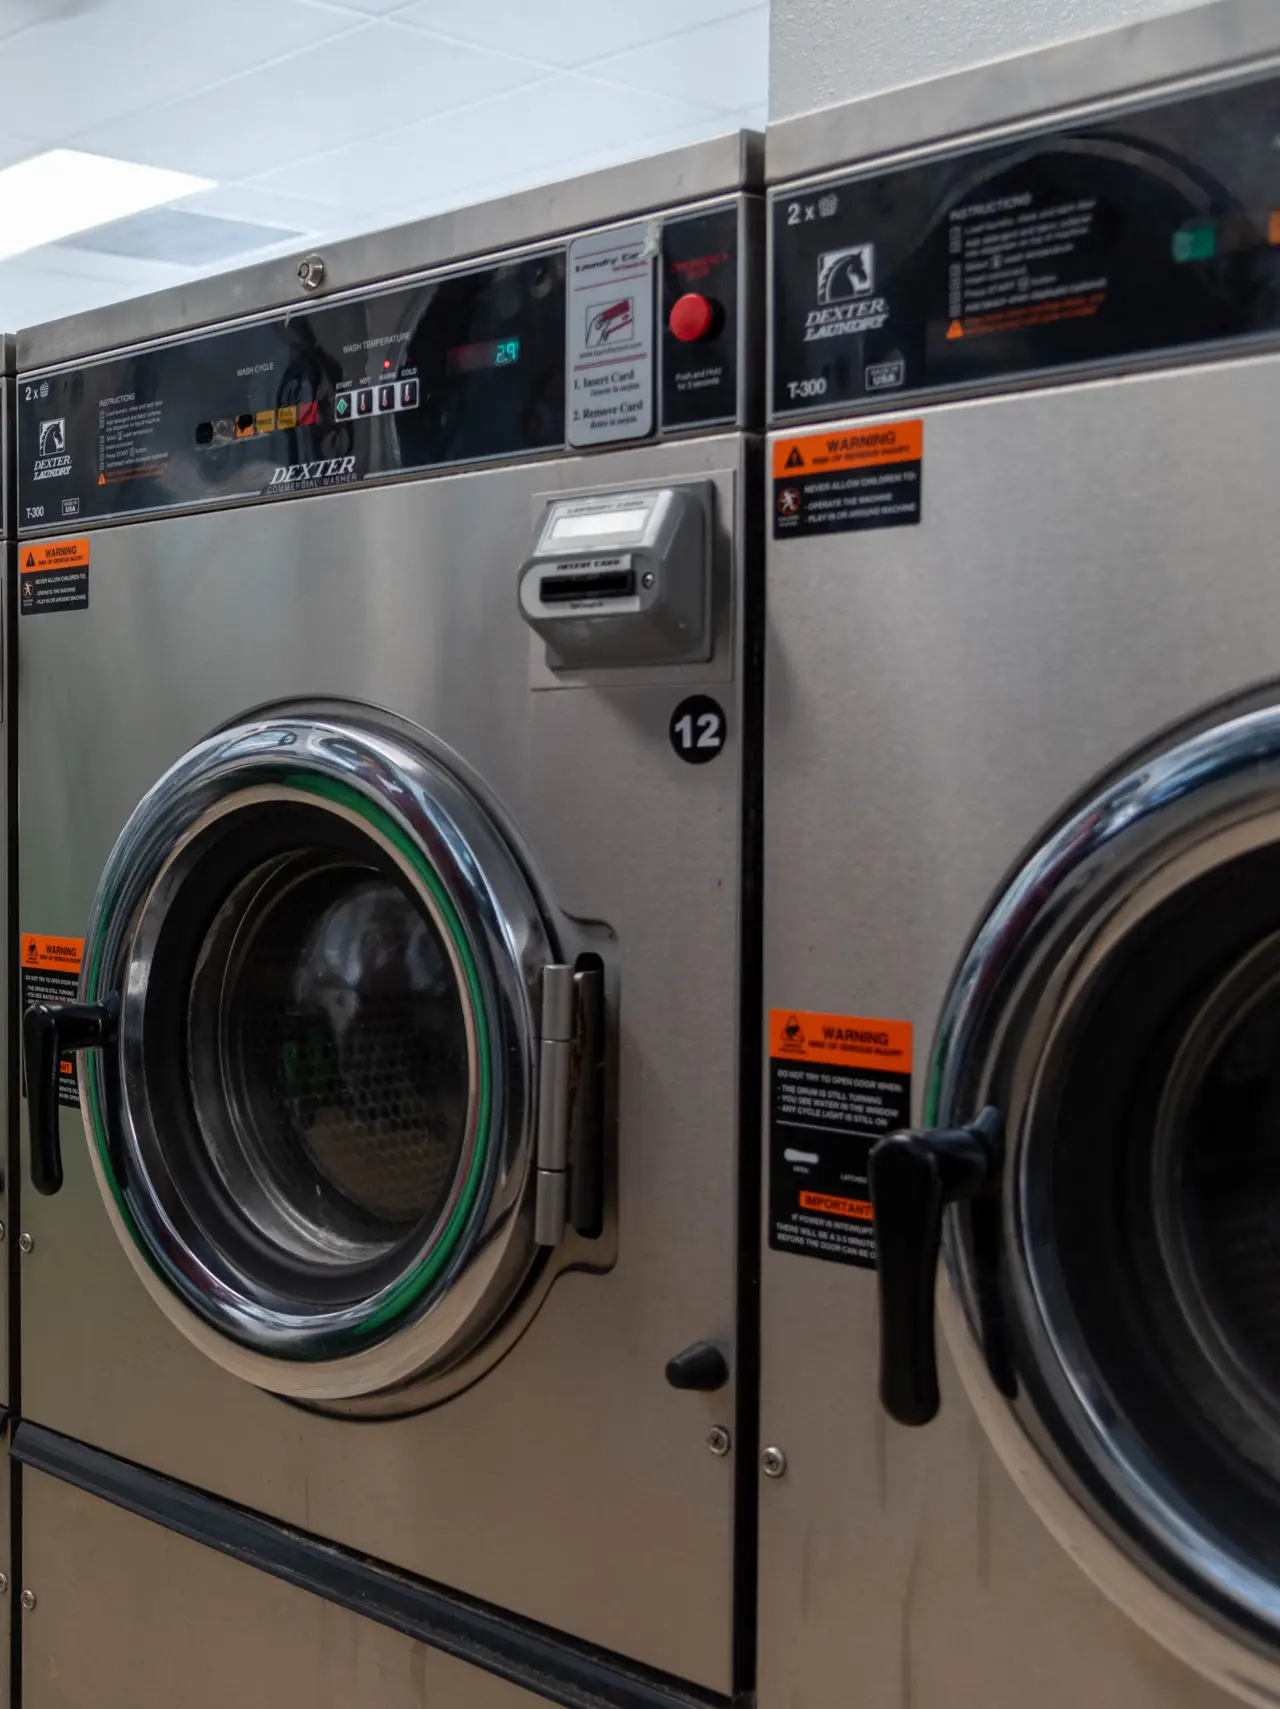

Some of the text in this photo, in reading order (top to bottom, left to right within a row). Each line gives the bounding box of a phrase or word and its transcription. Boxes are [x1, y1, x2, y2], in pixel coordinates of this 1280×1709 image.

[787, 202, 801, 225] 2
[949, 192, 1032, 221] INSTRUCTIONS
[804, 298, 886, 328] DEXTER
[803, 313, 890, 341] LAUNDRY
[342, 331, 412, 354] WASH TEMPERATURE
[496, 341, 516, 363] 29
[237, 362, 274, 377] WASH CYCLE
[336, 381, 352, 390] START
[360, 377, 371, 385] HOT
[401, 367, 417, 377] COLD
[583, 375, 609, 388] Insert
[611, 369, 634, 383] Card
[675, 372, 693, 381] Push
[694, 370, 705, 379] and
[693, 377, 719, 387] seconds
[787, 377, 827, 399] T-300
[25, 386, 32, 401] 2
[99, 392, 135, 407] INSTRUCTIONS
[583, 406, 617, 419] Remove
[620, 400, 643, 413] Card
[826, 430, 895, 452] WARNING
[33, 466, 72, 480] LAUNDRY
[34, 455, 71, 471] DEXTER
[270, 455, 356, 485] DEXTER
[267, 473, 357, 495] COMMERCIAL WASHER
[804, 482, 830, 494] NEVER
[831, 479, 859, 491] ALLOW
[861, 474, 902, 487] CHILDREN
[65, 505, 76, 513] USA
[844, 496, 857, 507] THE
[858, 492, 893, 505] MACHINE
[26, 505, 44, 518] T-300
[849, 506, 879, 519] AROUND
[881, 502, 916, 515] MACHINE
[45, 546, 76, 558] WARNING
[557, 559, 620, 570] INSERT CARD
[675, 713, 720, 749] 12
[46, 944, 76, 957] WARNING
[822, 1026, 889, 1046] WARNING
[777, 1069, 788, 1078] DO
[789, 1071, 804, 1080] NOT
[805, 1072, 819, 1082] TRY
[821, 1074, 831, 1084] TO
[832, 1076, 852, 1087] OPEN
[853, 1078, 876, 1090] DOOR
[782, 1084, 795, 1094] THE
[796, 1086, 817, 1097] DRUM
[827, 1090, 847, 1100] STILL
[848, 1093, 882, 1106] TURNING
[781, 1104, 796, 1114] ANY
[797, 1107, 820, 1118] CYCLE
[822, 1110, 844, 1120] LIGHT
[853, 1114, 873, 1125] STILL
[875, 1117, 888, 1126] ON
[782, 1094, 796, 1104] YOU
[798, 1096, 812, 1106] SEE
[813, 1098, 839, 1110] WATER
[849, 1102, 864, 1113] THE
[865, 1105, 899, 1118] WINDOW
[793, 1165, 809, 1174] OPEN
[804, 1195, 872, 1217] IMPORTANT
[776, 1222, 799, 1234] THERE
[800, 1226, 817, 1238] WILL
[818, 1230, 829, 1239] BE
[799, 1215, 825, 1227] POWER
[777, 1232, 805, 1245] BEFORE
[806, 1238, 820, 1248] THE
[821, 1240, 842, 1252] DOOR
[842, 1245, 858, 1256] CAN
[859, 1248, 869, 1258] BE
